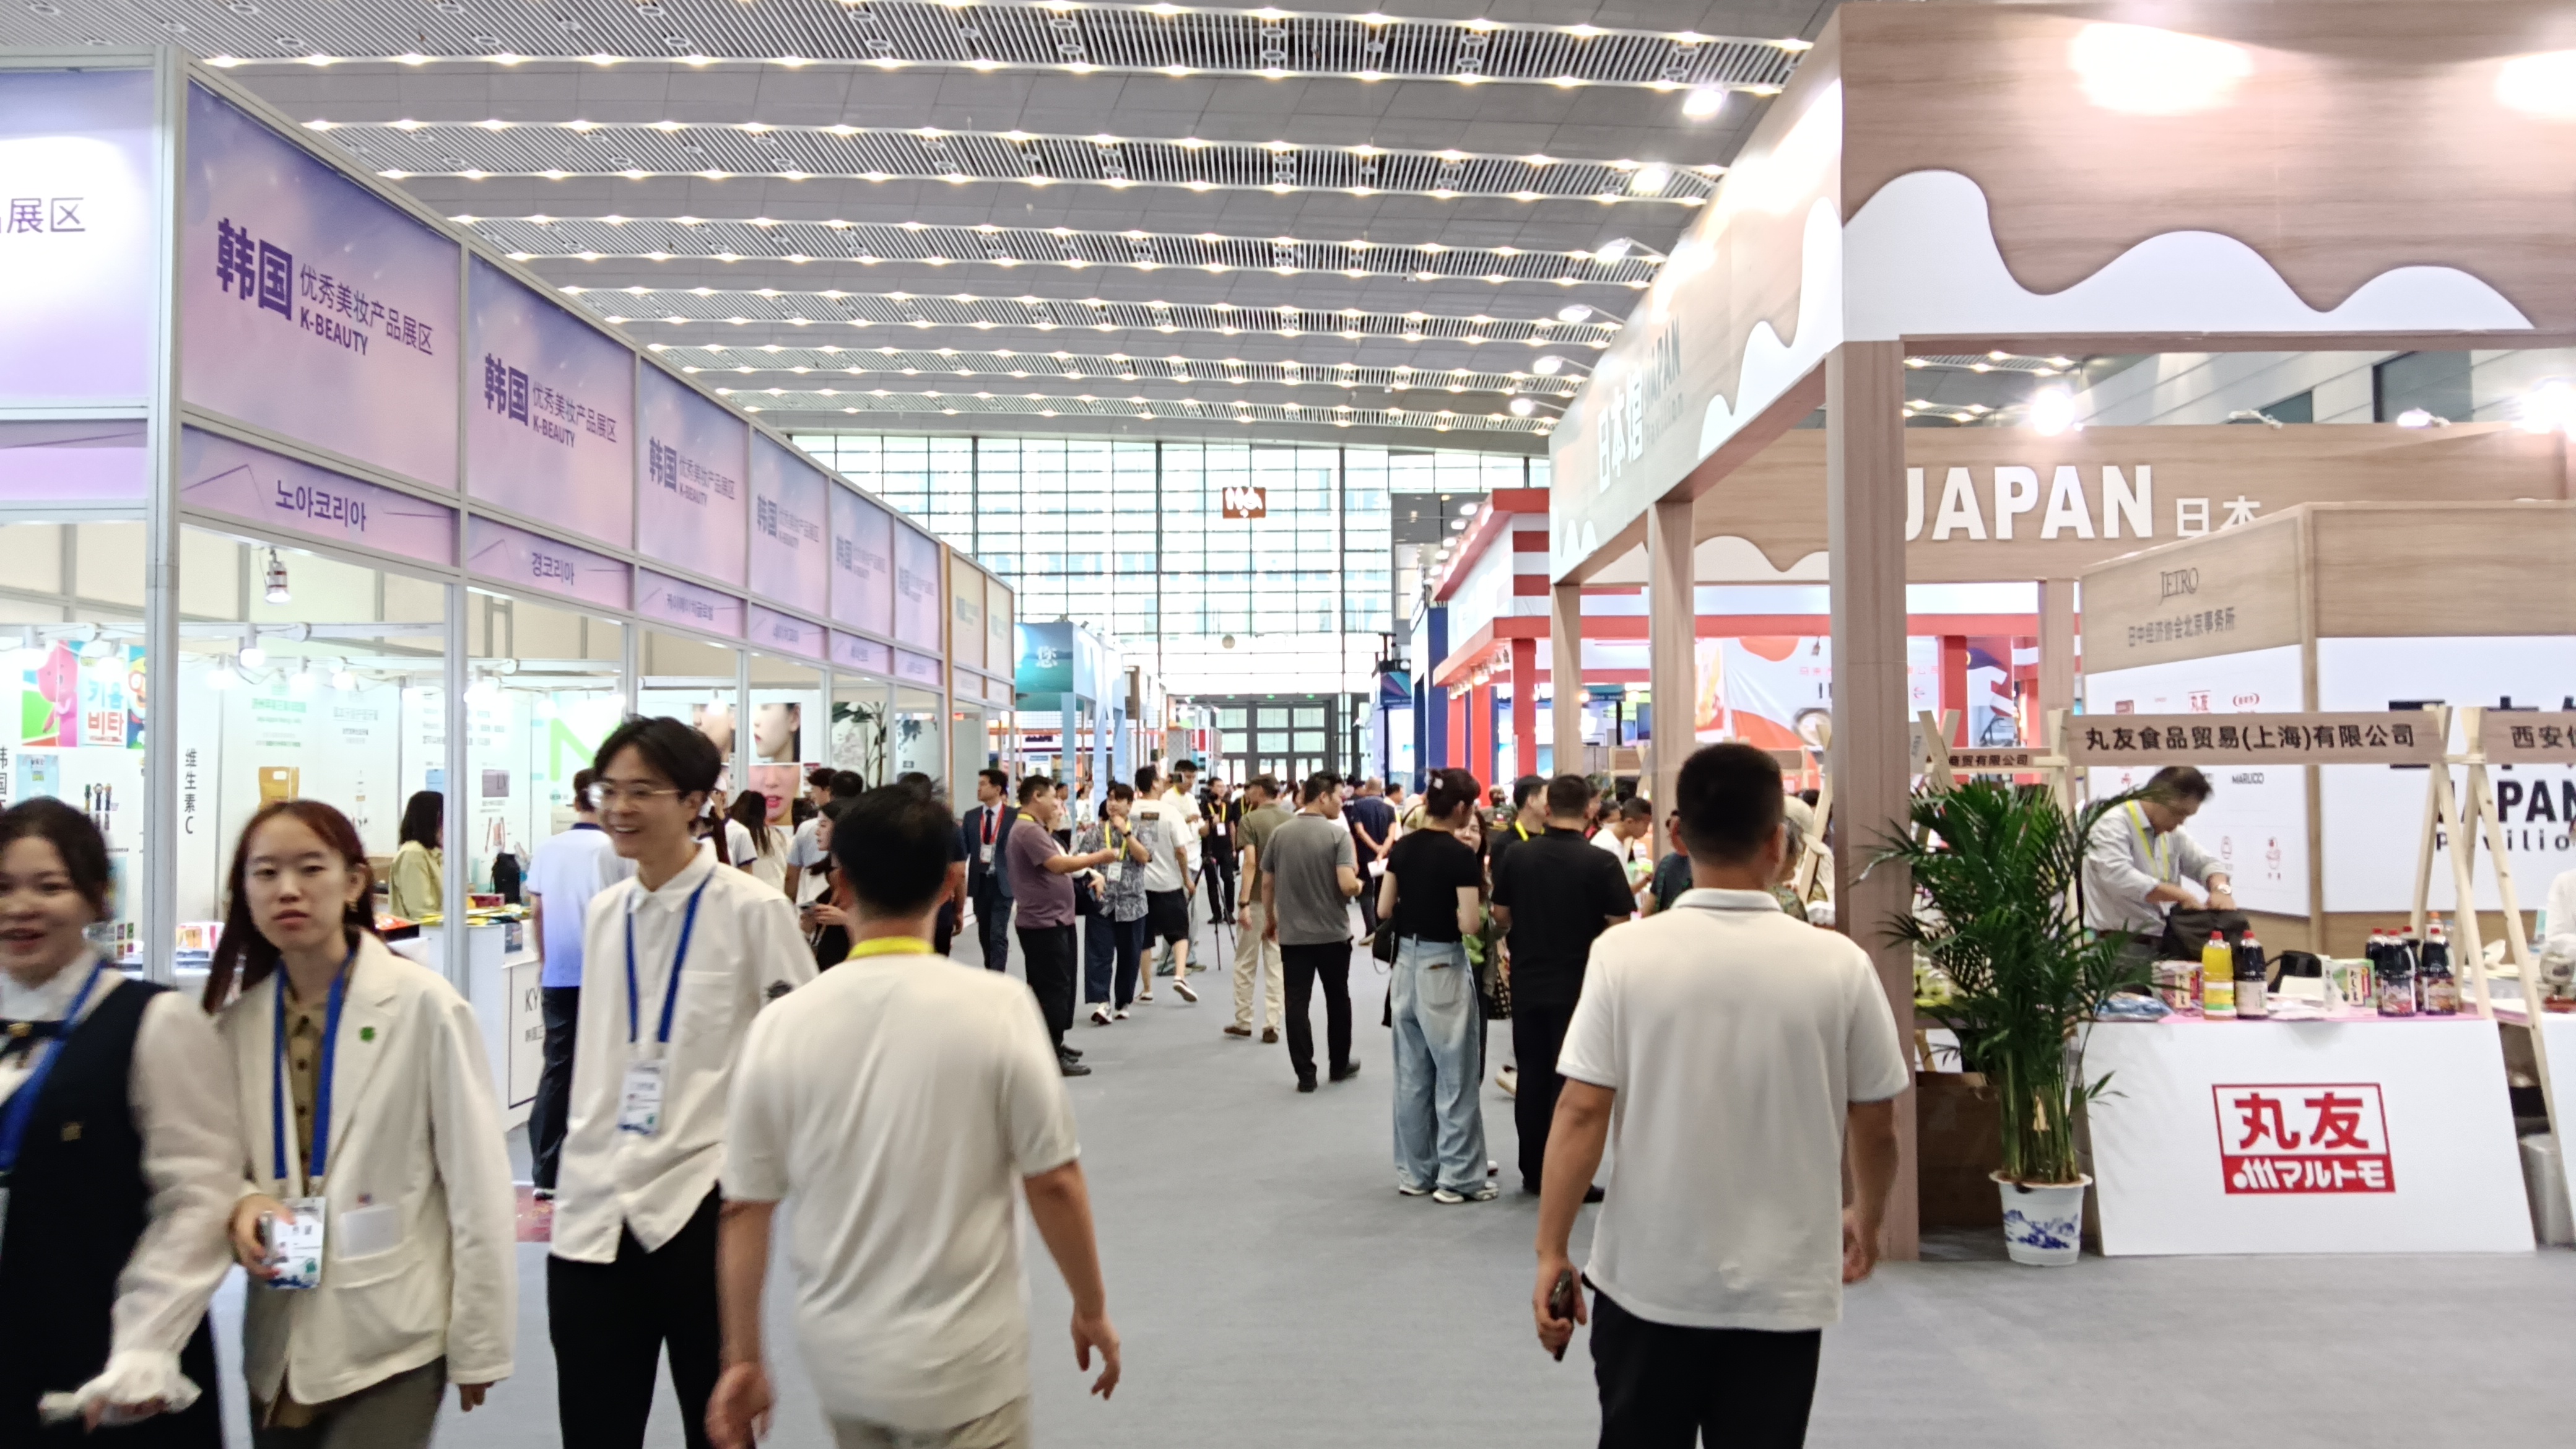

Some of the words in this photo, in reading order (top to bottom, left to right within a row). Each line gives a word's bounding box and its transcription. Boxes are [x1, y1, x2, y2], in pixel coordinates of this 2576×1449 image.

[0, 198, 85, 233] 展区
[217, 218, 292, 320] 韩国
[300, 264, 432, 355] 优秀美妆产品展区
[300, 307, 368, 355] K-BEAUTY
[485, 353, 528, 426] 韩国
[533, 381, 617, 443] 优秀美妆产品展区
[533, 415, 575, 448] K-BEAUTY
[649, 436, 677, 493] 韩国
[276, 480, 367, 531] 노아코리아
[1906, 465, 2153, 541] JAPAN
[2175, 495, 2261, 537] 日本
[532, 552, 575, 586] 경코리아
[2159, 567, 2199, 606] JETRO
[88, 711, 124, 736] 비타
[2086, 724, 2414, 752] 丸友食品贸易(上海)有限公司
[185, 748, 198, 834] 维生素C
[2234, 1092, 2369, 1150] 丸友
[2274, 1159, 2385, 1189] マルトモ
